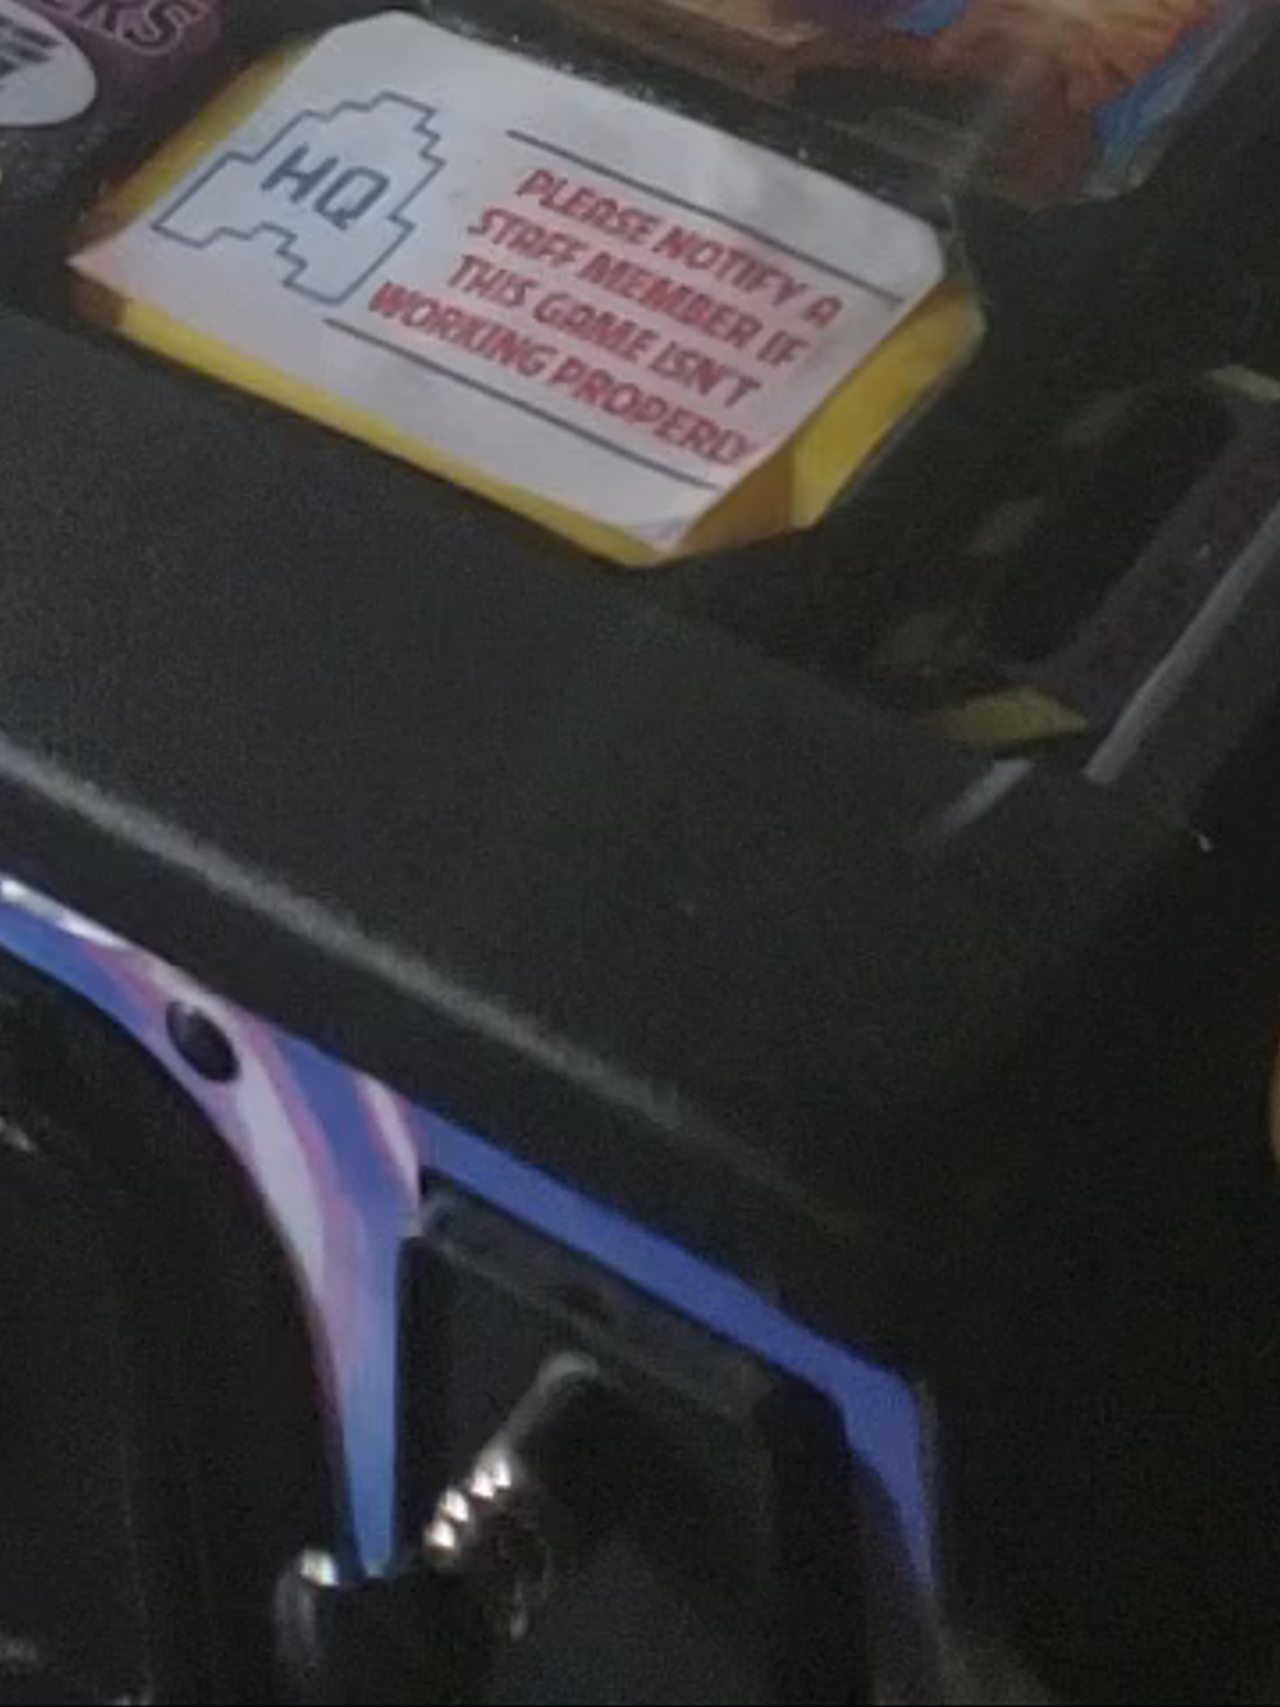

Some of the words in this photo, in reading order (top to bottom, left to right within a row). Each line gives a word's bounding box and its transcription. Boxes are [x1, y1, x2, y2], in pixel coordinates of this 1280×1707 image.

[260, 139, 393, 231] HQ
[516, 166, 654, 251] PLEASE
[657, 221, 804, 311] NOTIFY
[806, 292, 844, 331] A
[446, 253, 526, 313] THIS
[532, 290, 655, 364] GAME
[657, 338, 762, 411] ISN'T
[467, 206, 580, 276] STAFF
[582, 250, 758, 355] MEMBER
[763, 329, 810, 373] IF
[367, 280, 546, 380] WORKING
[547, 350, 761, 468] PROPERLY
